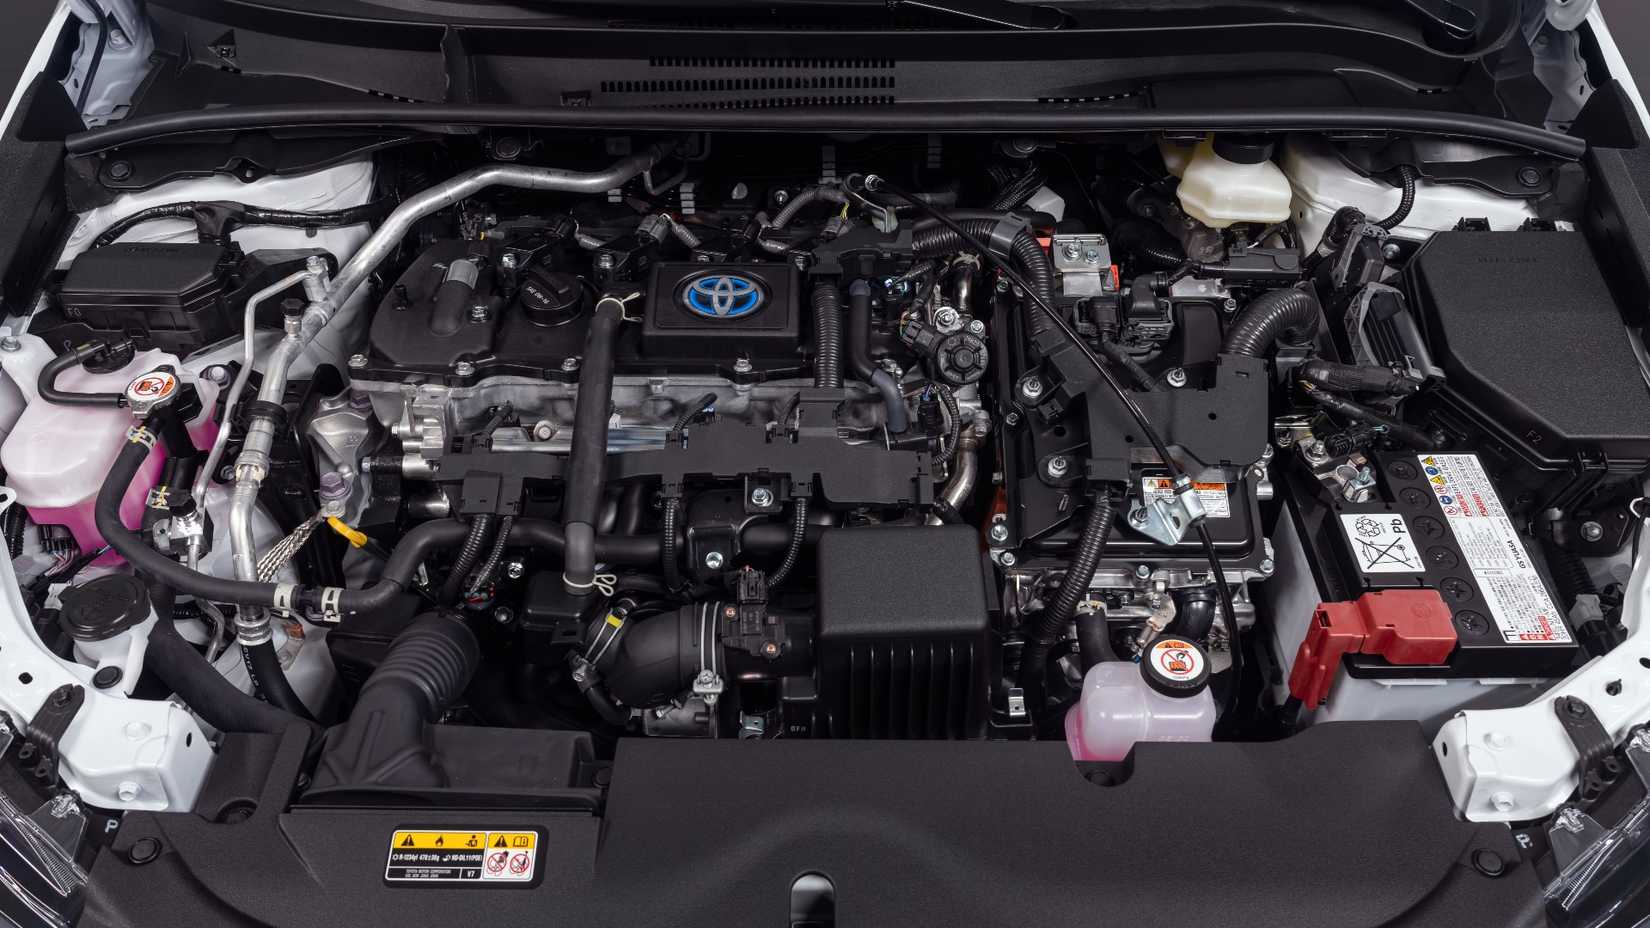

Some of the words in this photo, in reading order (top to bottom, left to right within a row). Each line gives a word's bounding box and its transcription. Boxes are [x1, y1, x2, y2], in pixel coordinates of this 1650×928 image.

[1526, 430, 1542, 442] F2
[1390, 518, 1406, 534] Pb
[1507, 540, 1521, 560] YUASA
[1517, 560, 1526, 568] GS
